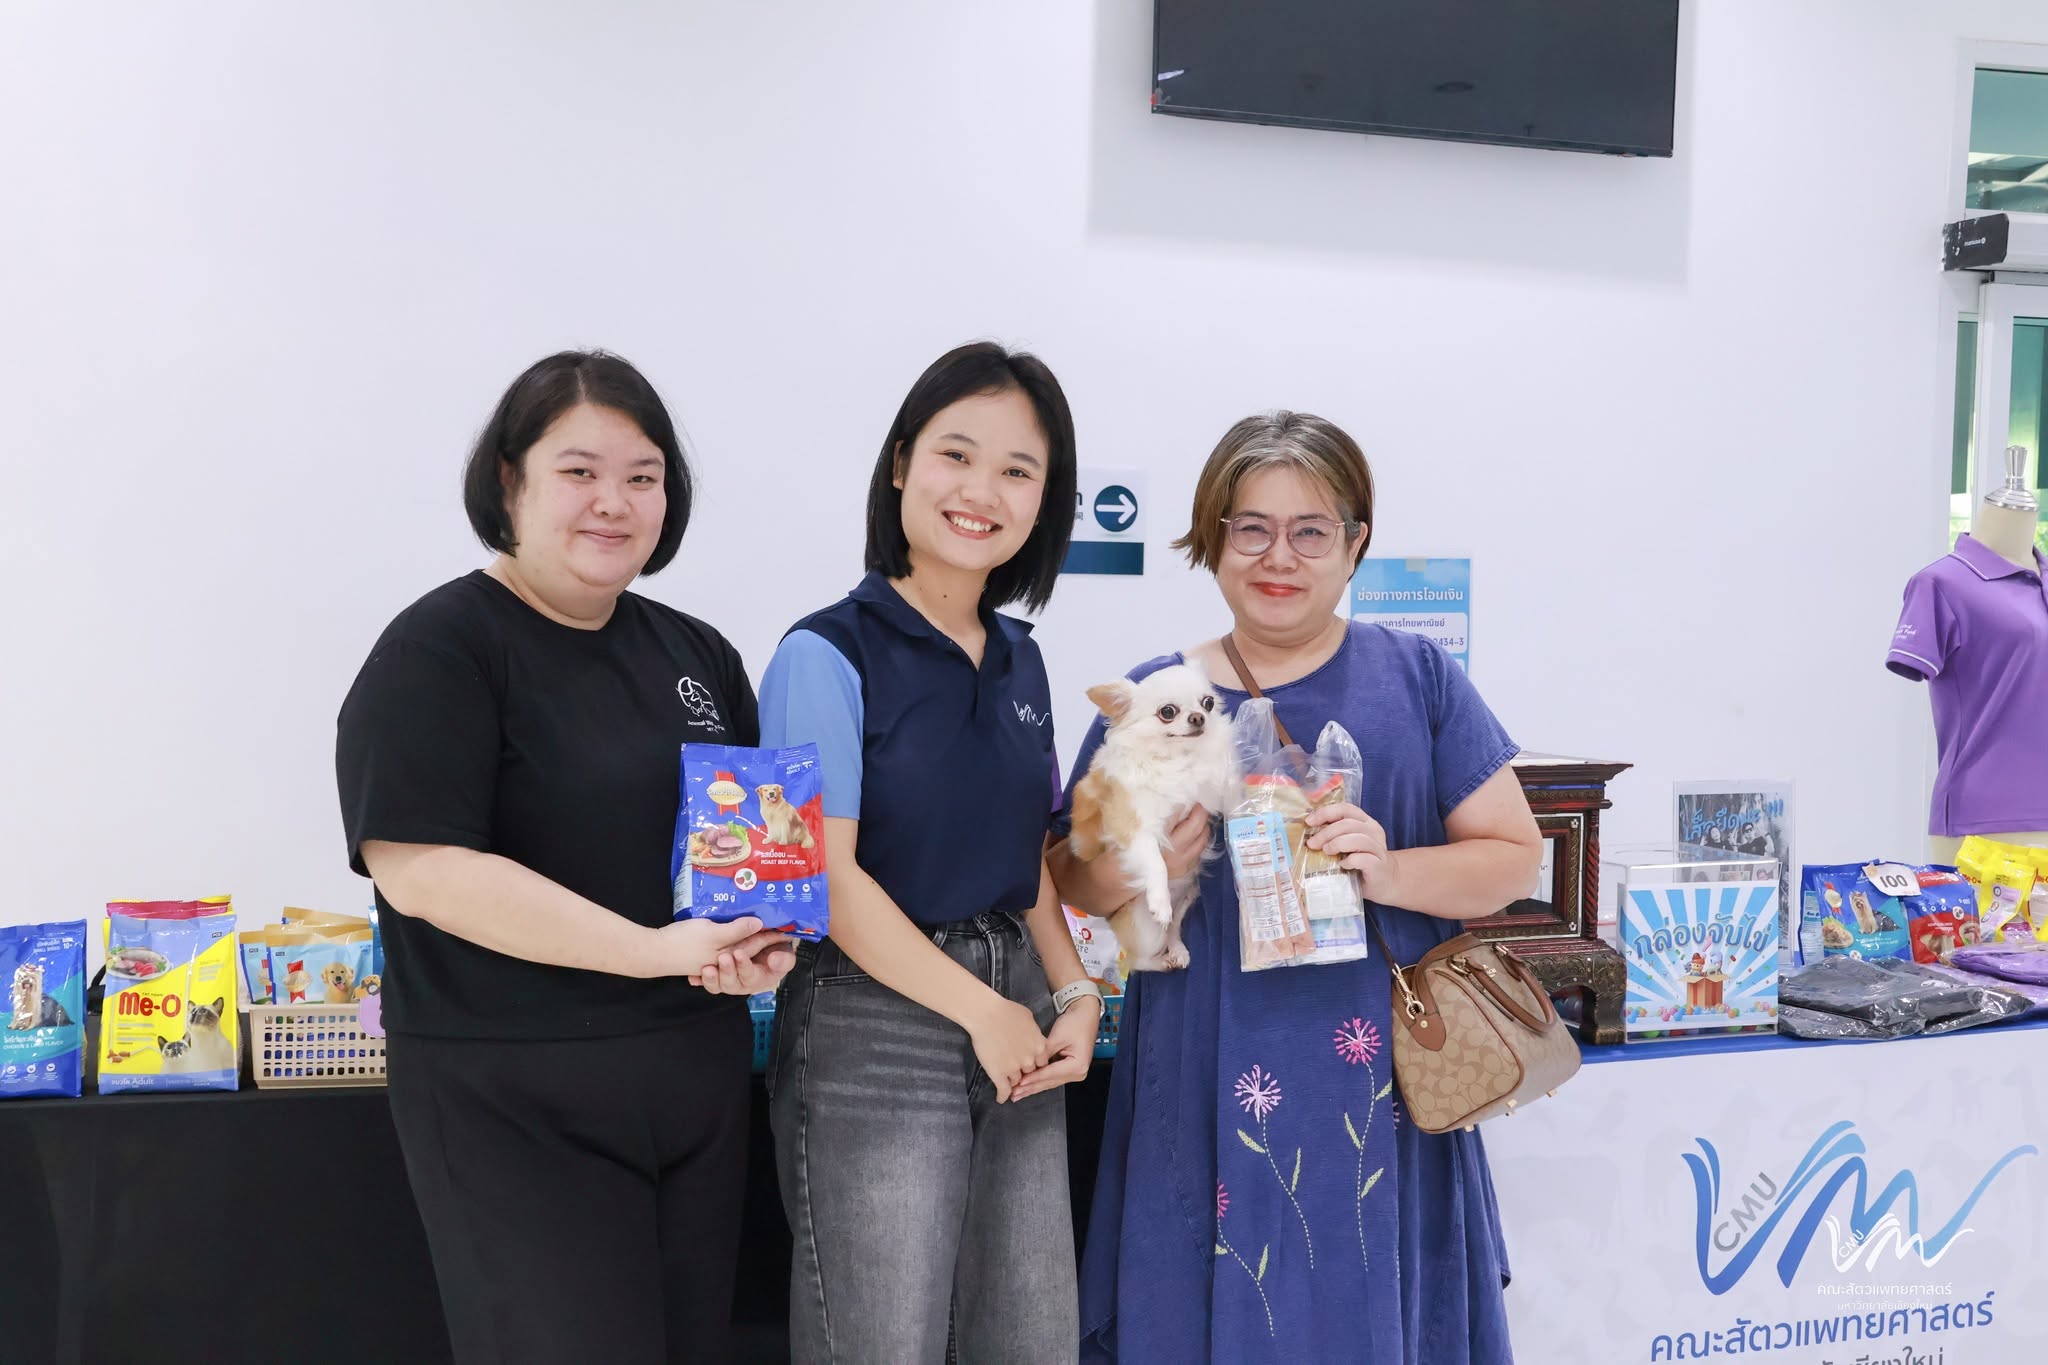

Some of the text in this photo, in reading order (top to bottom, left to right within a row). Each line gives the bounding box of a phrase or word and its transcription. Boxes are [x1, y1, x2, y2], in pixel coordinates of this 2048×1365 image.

[1357, 587, 1464, 601] ช่องทางการโอนเงิน
[1880, 875, 1908, 888] 100
[713, 893, 736, 903] 500 g
[1634, 913, 1772, 959] กล่องจับไข่
[119, 992, 181, 1018] Me-O
[1713, 1172, 1778, 1252] CMU
[1651, 1291, 1995, 1362] คณะสัตวแพทยศาสตร์
